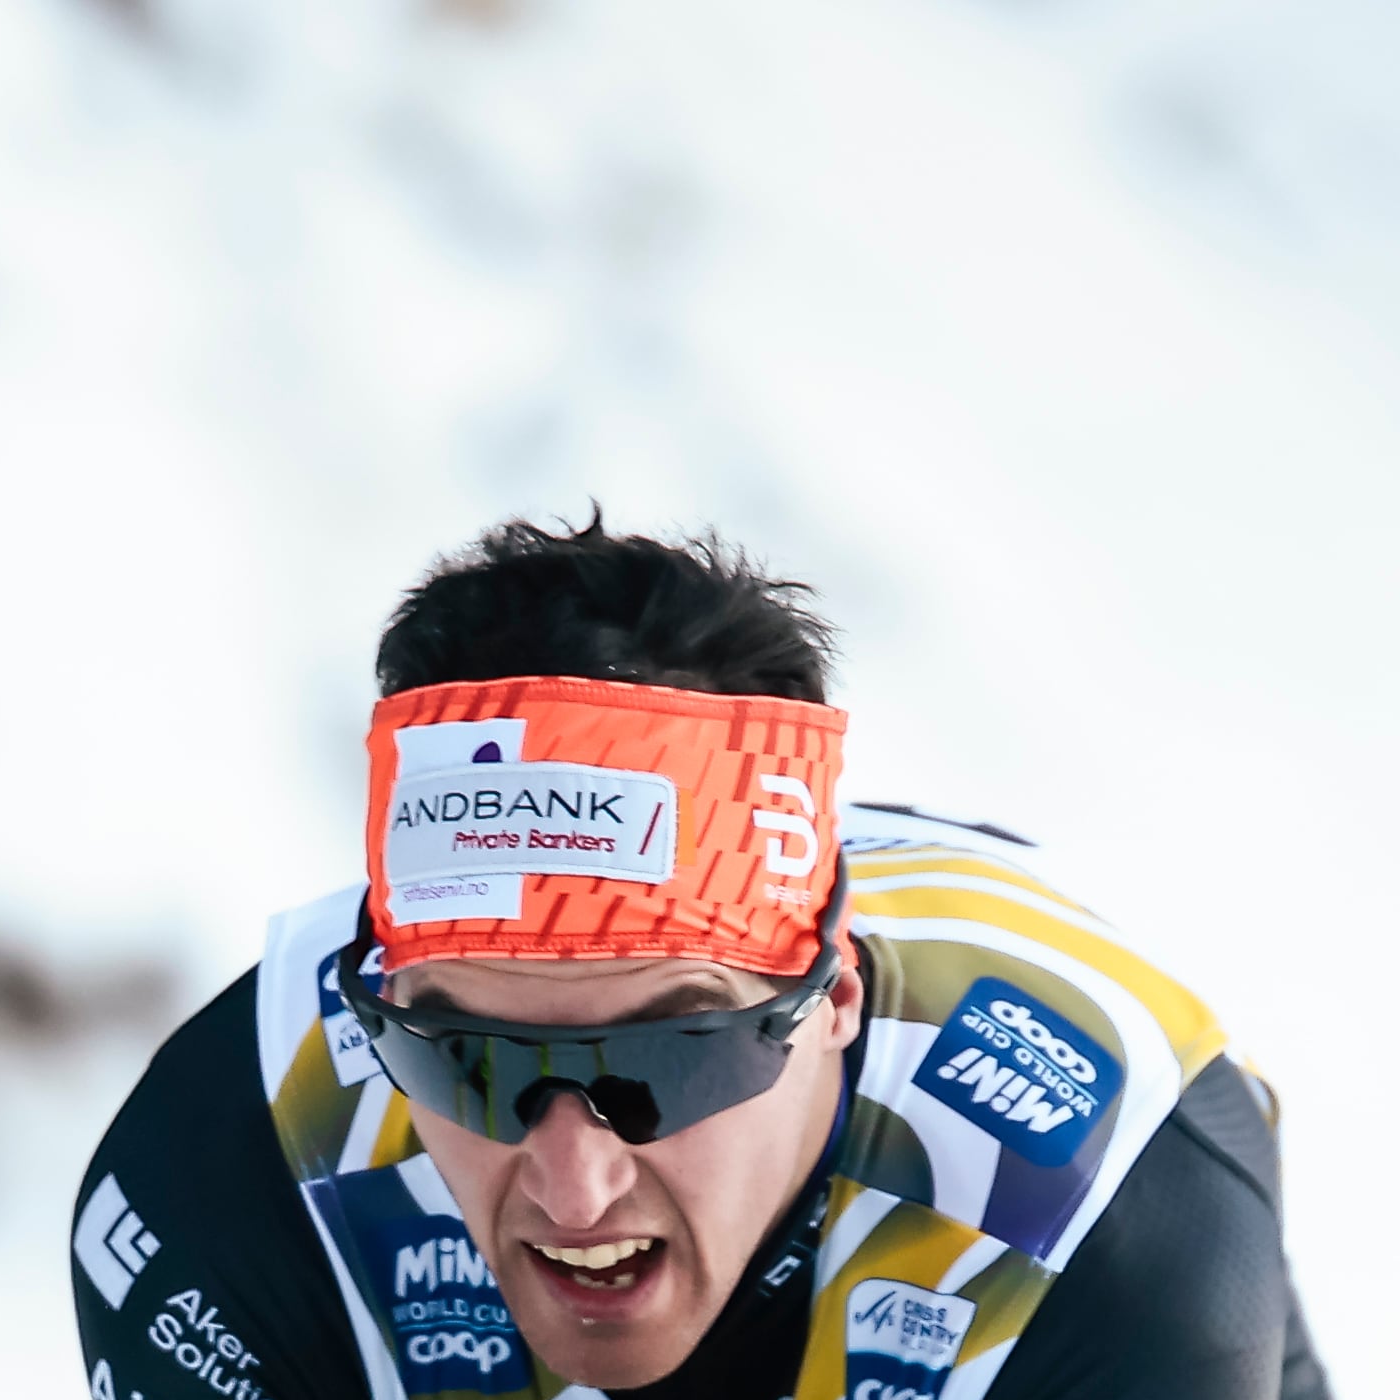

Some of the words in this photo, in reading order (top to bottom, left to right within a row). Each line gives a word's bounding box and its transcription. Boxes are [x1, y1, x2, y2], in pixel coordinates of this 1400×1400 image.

[453, 830, 521, 852] Private
[527, 828, 619, 853] Bankers
[961, 1013, 1012, 1050] CUP
[989, 999, 1098, 1085] coop
[1013, 1047, 1094, 1118] WORLD
[163, 1287, 262, 1362] Aker
[407, 1331, 512, 1375] coop
